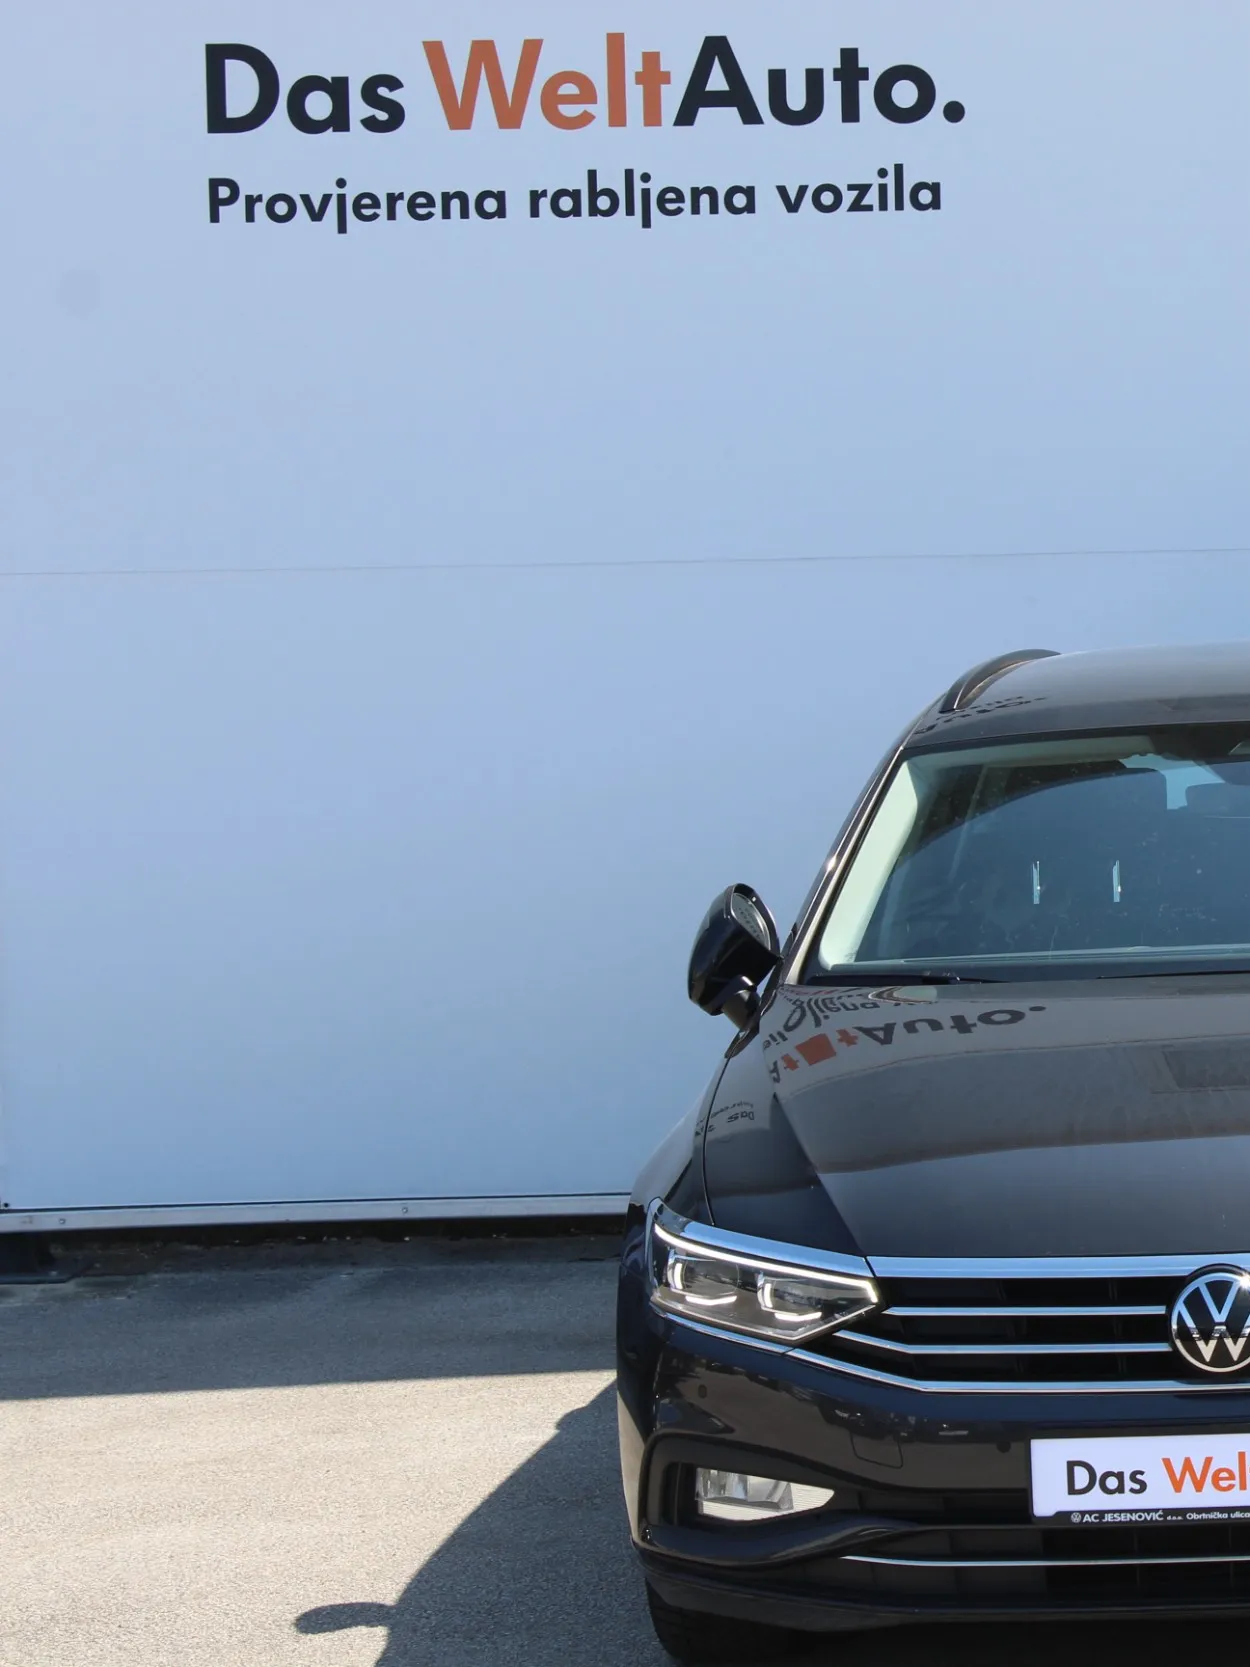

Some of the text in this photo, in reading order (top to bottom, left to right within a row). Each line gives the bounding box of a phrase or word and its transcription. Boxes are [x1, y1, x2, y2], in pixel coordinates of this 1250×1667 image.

[205, 33, 966, 134] Das WeltAuto.
[207, 164, 942, 234] Provjerena rabljena vozila
[1066, 1460, 1147, 1495] Das
[1082, 1513, 1099, 1523] AC
[1102, 1510, 1164, 1522] JESENOVIĆ
[1186, 1511, 1228, 1520] Obrtnička
[1230, 1510, 1250, 1519] ulica
